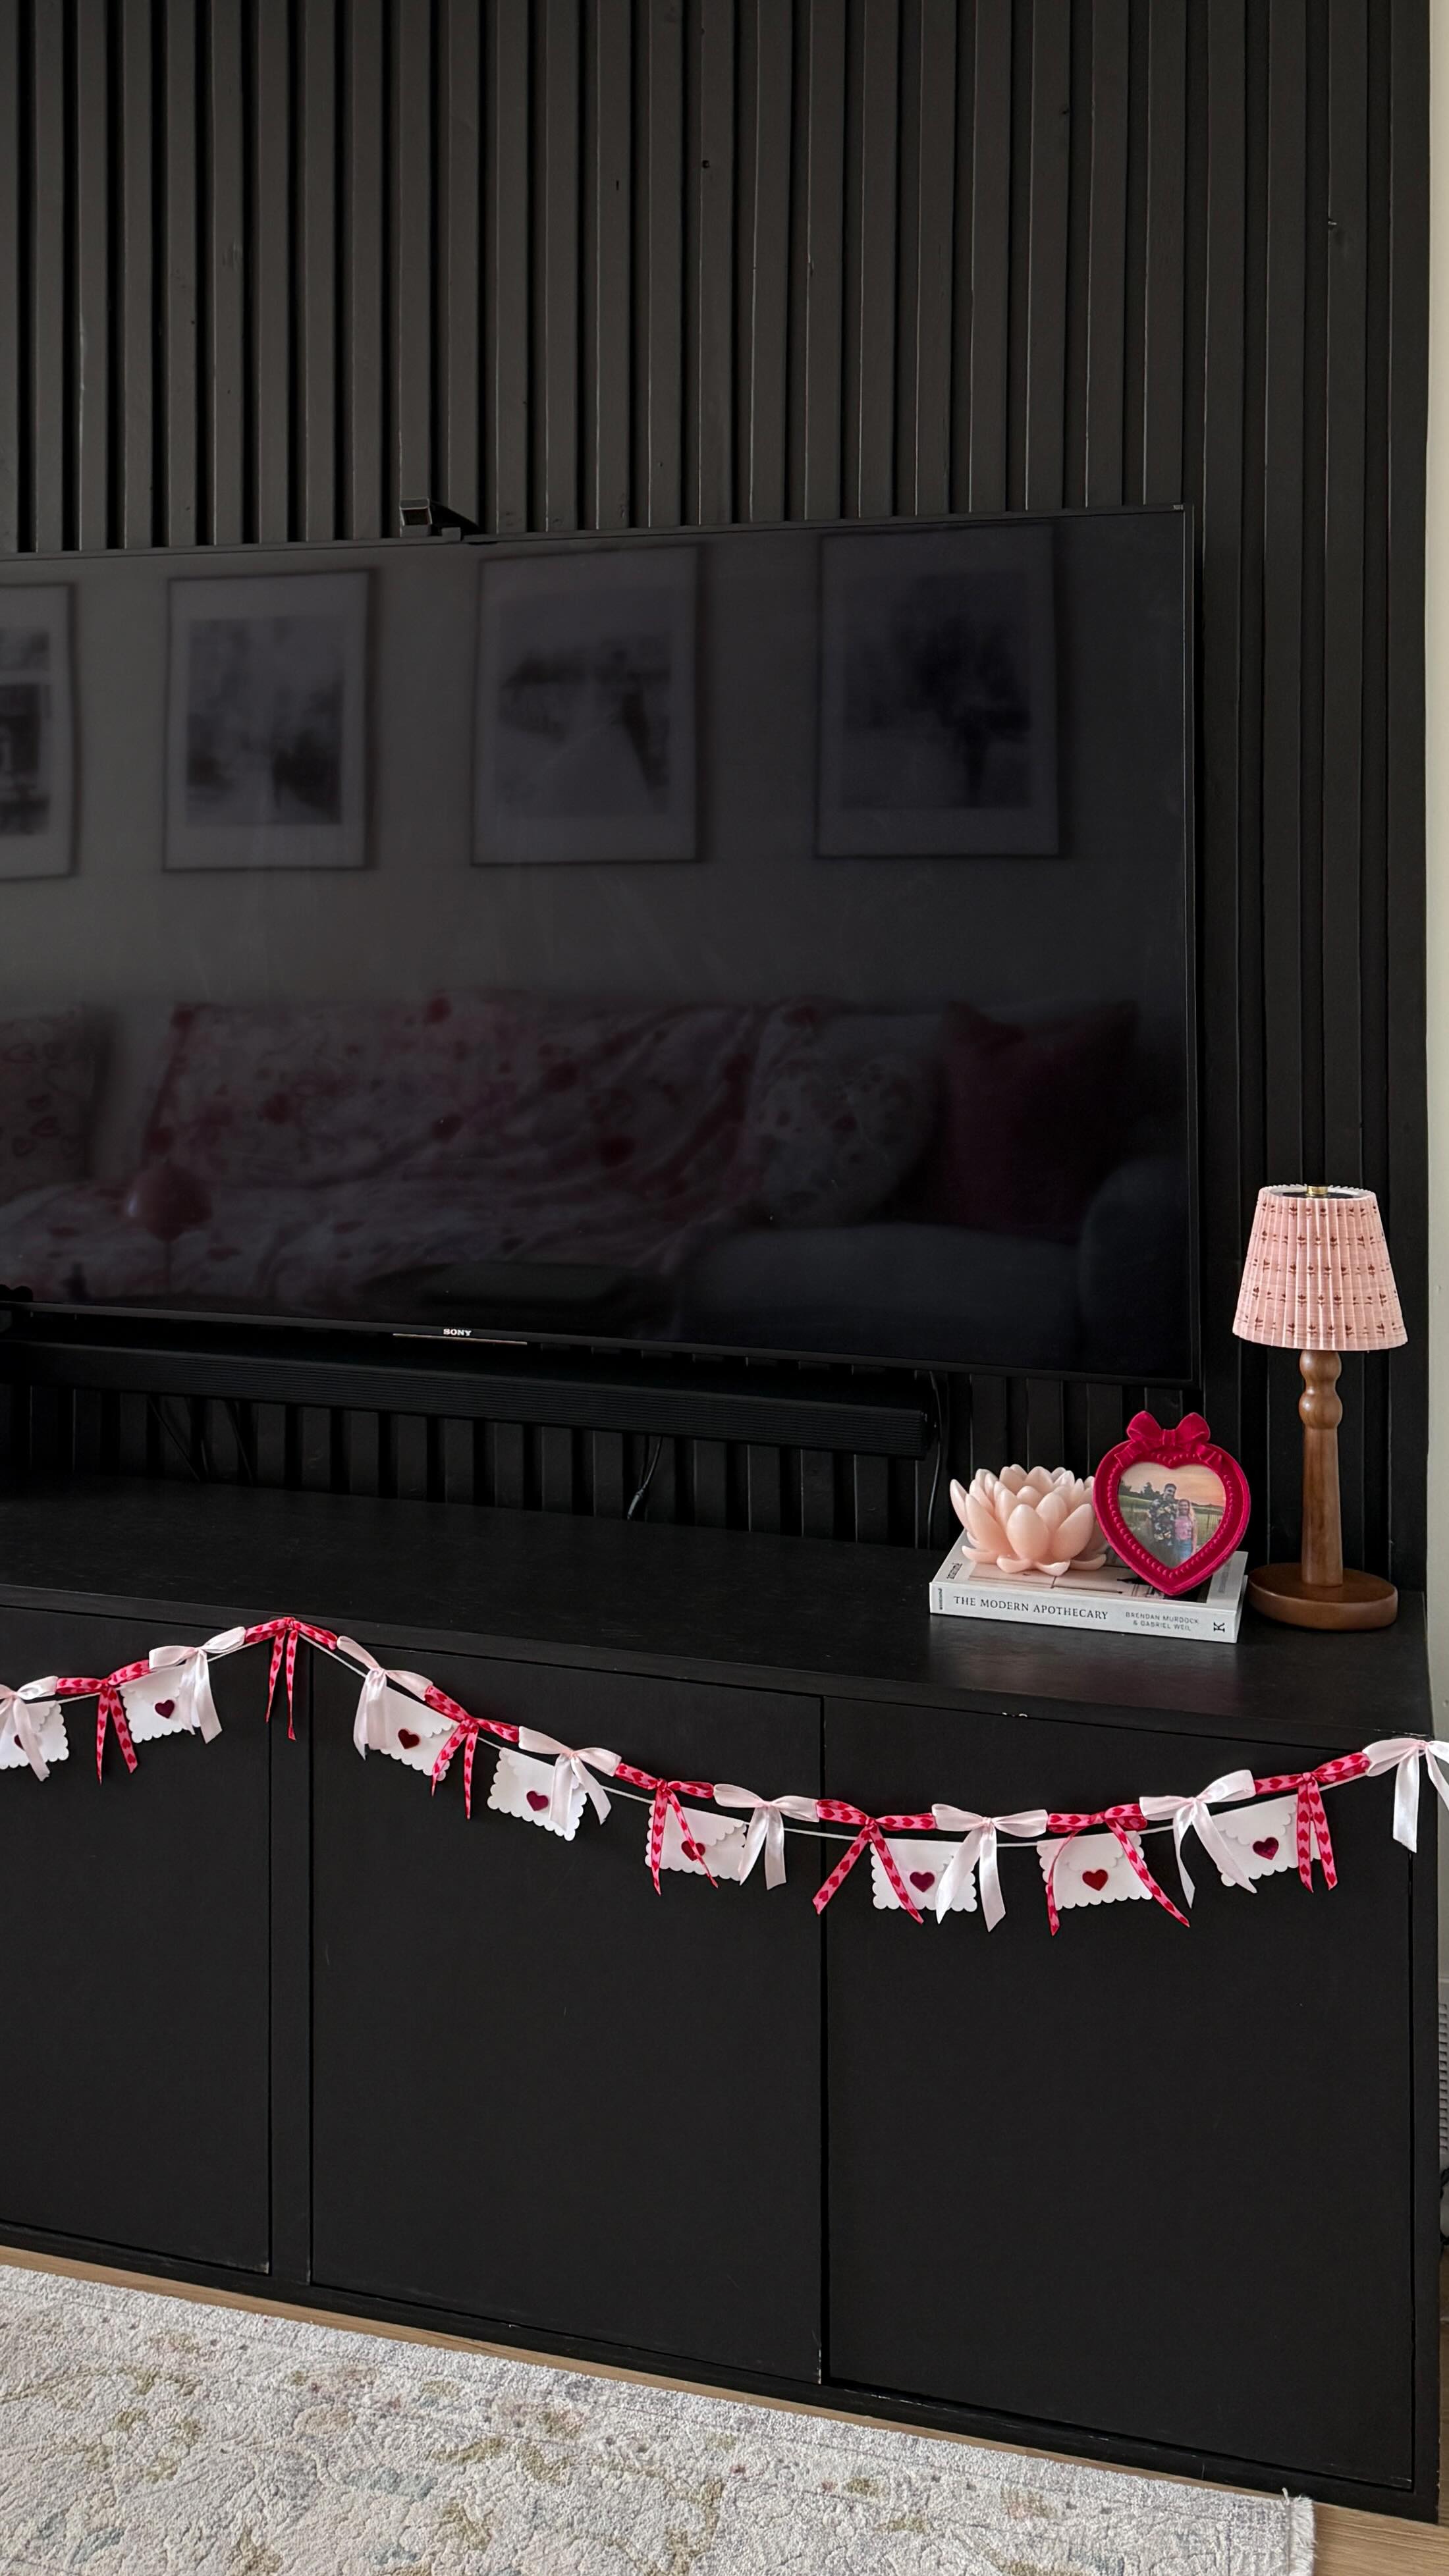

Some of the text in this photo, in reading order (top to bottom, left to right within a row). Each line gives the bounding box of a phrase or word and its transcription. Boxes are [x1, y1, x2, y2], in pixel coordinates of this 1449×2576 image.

[953, 1596, 976, 1606] THE
[980, 1599, 1029, 1611] MODERN
[1033, 1604, 1108, 1620] APOTHECARY
[1162, 1615, 1199, 1624] MURDOCK
[1213, 1622, 1225, 1632] K
